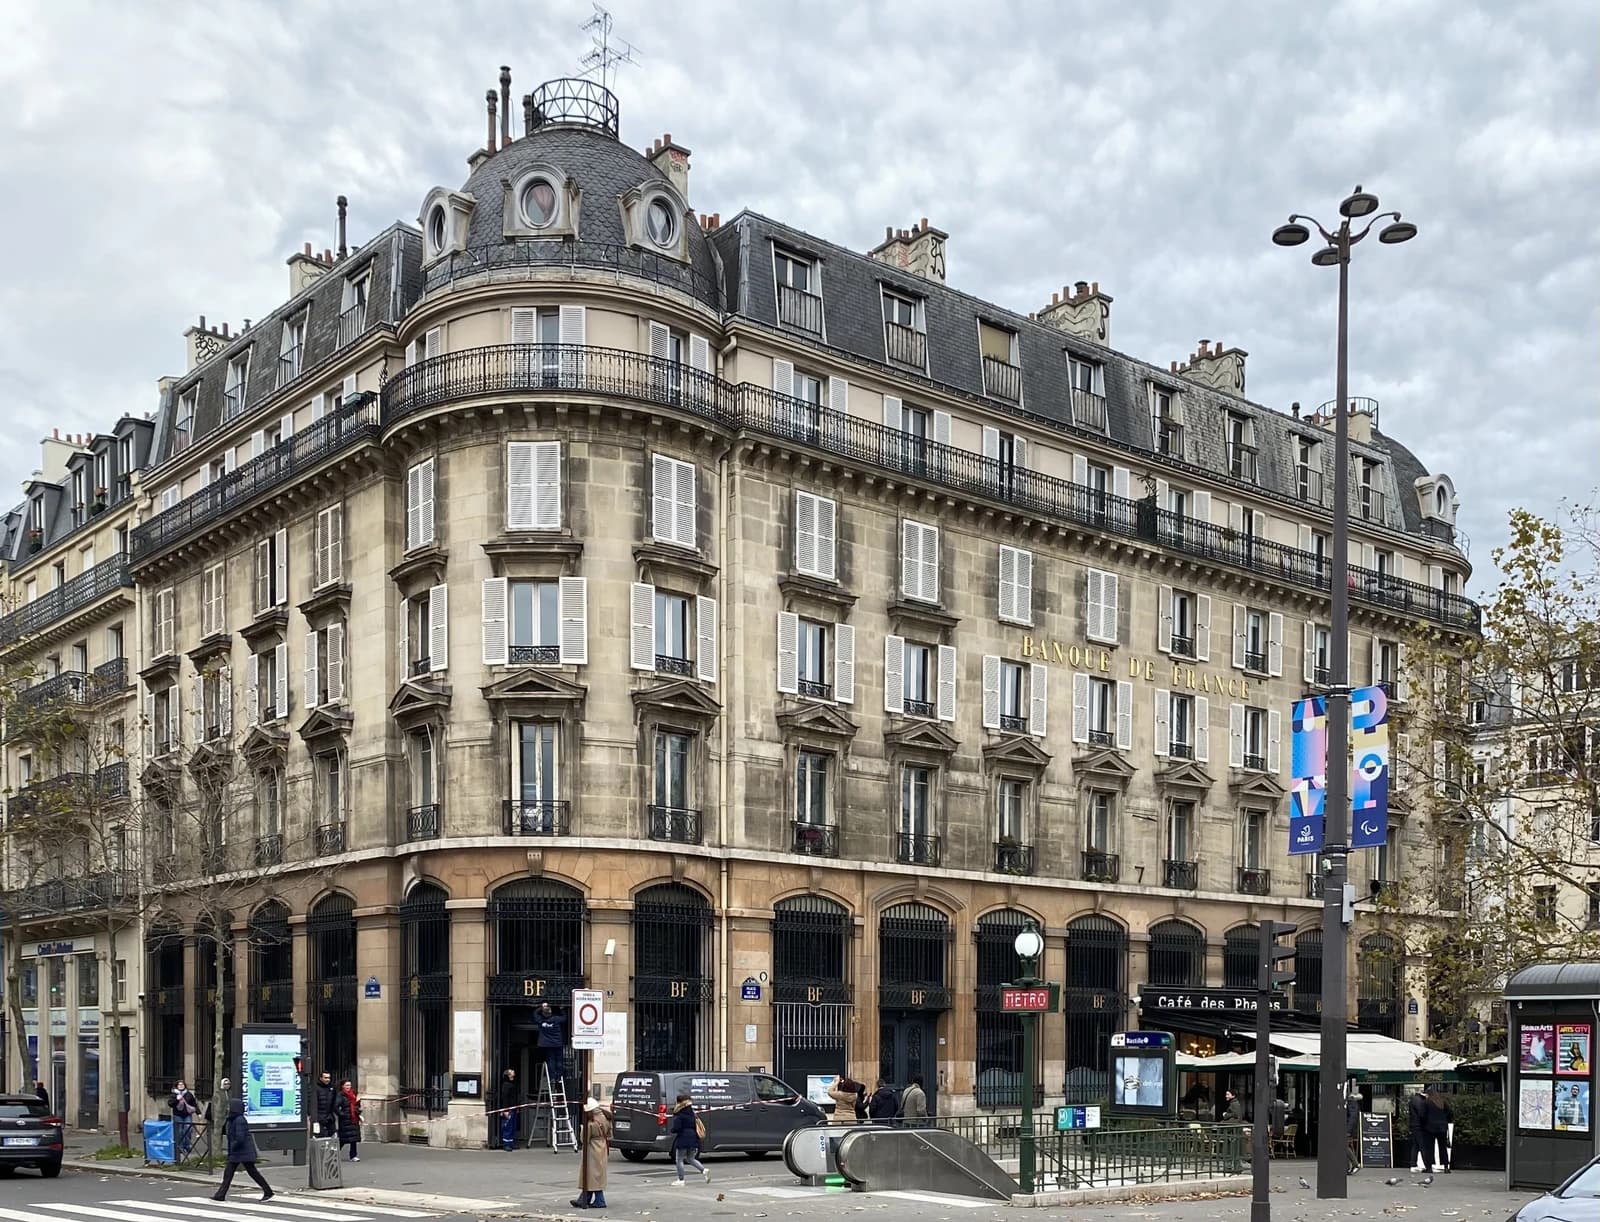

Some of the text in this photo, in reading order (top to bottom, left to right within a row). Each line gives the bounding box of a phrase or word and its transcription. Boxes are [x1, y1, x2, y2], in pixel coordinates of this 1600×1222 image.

[1023, 635, 1250, 700] BANQUE DE FRANCE
[1297, 834, 1315, 844] PARIS
[262, 986, 271, 1001] BF
[324, 983, 334, 999] BF
[523, 980, 546, 996] BF
[671, 981, 689, 998] BF
[807, 986, 824, 1002] BF
[911, 990, 927, 1005] BF
[1005, 992, 1046, 1007] METRO
[1093, 995, 1105, 1009] BF
[1158, 995, 1280, 1010] Café des Phas
[1379, 1001, 1388, 1014] BF
[1125, 1037, 1144, 1045] Bastille
